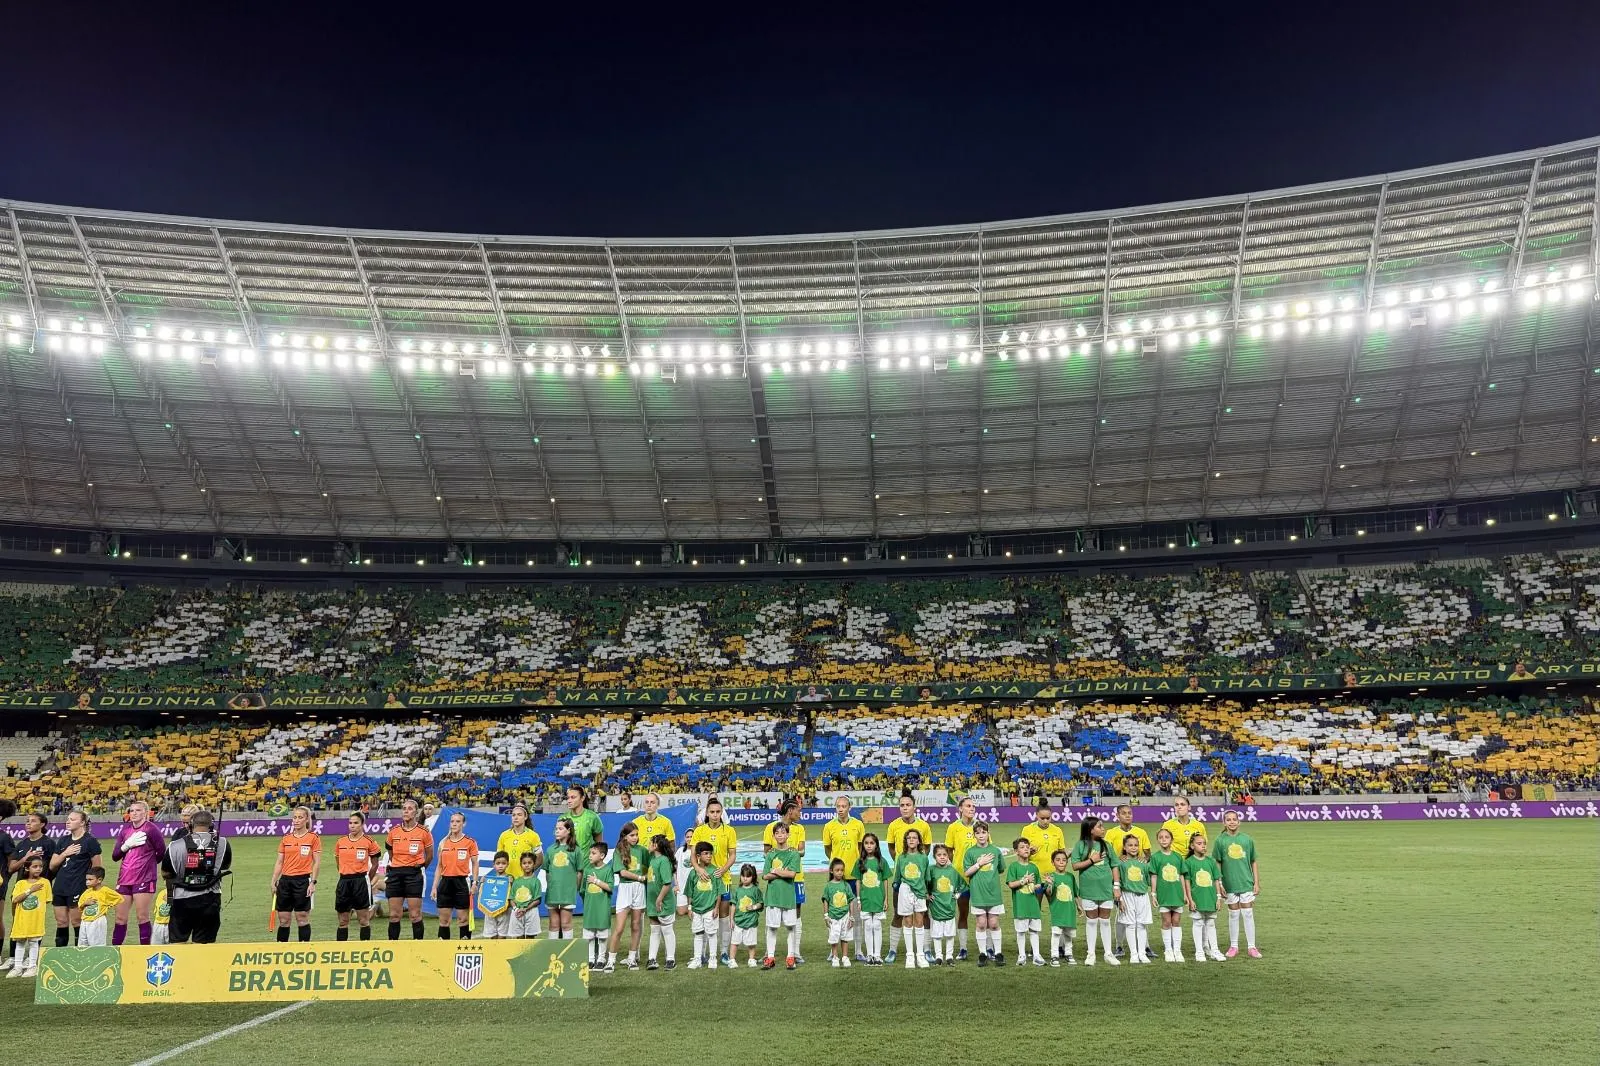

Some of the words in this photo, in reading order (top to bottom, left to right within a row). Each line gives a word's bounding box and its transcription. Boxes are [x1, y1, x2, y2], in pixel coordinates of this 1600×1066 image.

[1532, 664, 1575, 675] ARY
[1211, 676, 1292, 689] THAÍS
[1303, 678, 1326, 689] F.
[1358, 669, 1491, 685] ZANERATTO
[838, 687, 904, 698] LELÊ
[954, 685, 1020, 696] YAYA
[1062, 681, 1171, 693] LUDMILA
[100, 696, 216, 706] DUDINHA
[270, 695, 368, 706] ANGELINA
[408, 694, 514, 705] GUTIERRES
[565, 691, 651, 702] MARTA
[688, 690, 787, 702] KEROLIN
[1077, 808, 1110, 821] vivo
[1285, 806, 1319, 820] vivo
[1336, 806, 1370, 820] vivo
[1423, 804, 1457, 818] vivo
[1474, 803, 1508, 818] vivo
[1550, 803, 1585, 817] vivo
[728, 813, 771, 822] AMISTOSO
[235, 822, 265, 835] vivo
[231, 951, 317, 966] AMISTOSO
[320, 947, 394, 967] SELEÇÃO
[457, 955, 481, 969] USA
[229, 968, 394, 992] BRASILEIRA
[142, 989, 172, 997] BRASIL
